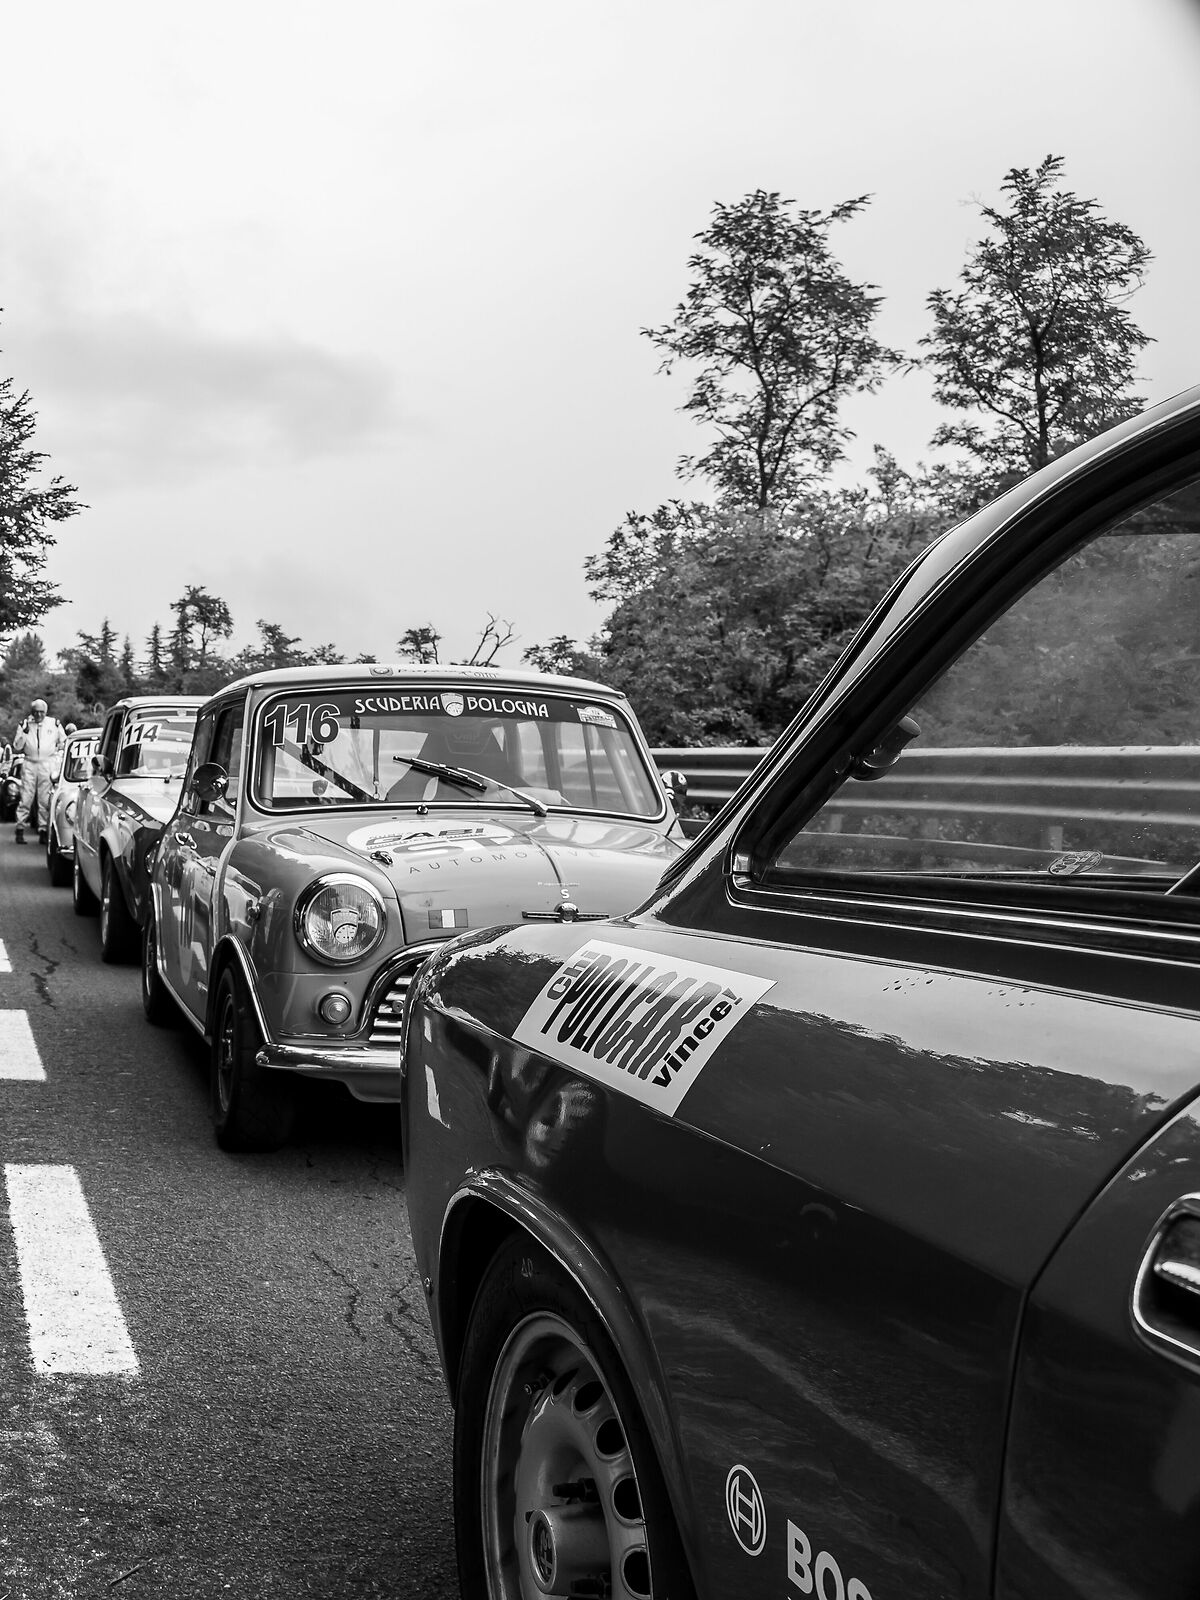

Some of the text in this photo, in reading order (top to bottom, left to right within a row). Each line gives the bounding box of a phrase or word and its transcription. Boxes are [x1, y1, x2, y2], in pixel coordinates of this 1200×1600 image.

[264, 703, 341, 746] 116
[354, 695, 550, 718] SCUDERIA BOLOGNA
[124, 723, 159, 745] 114
[546, 950, 598, 1001] chi
[540, 954, 723, 1081] POLICAR
[652, 987, 743, 1088] vince!
